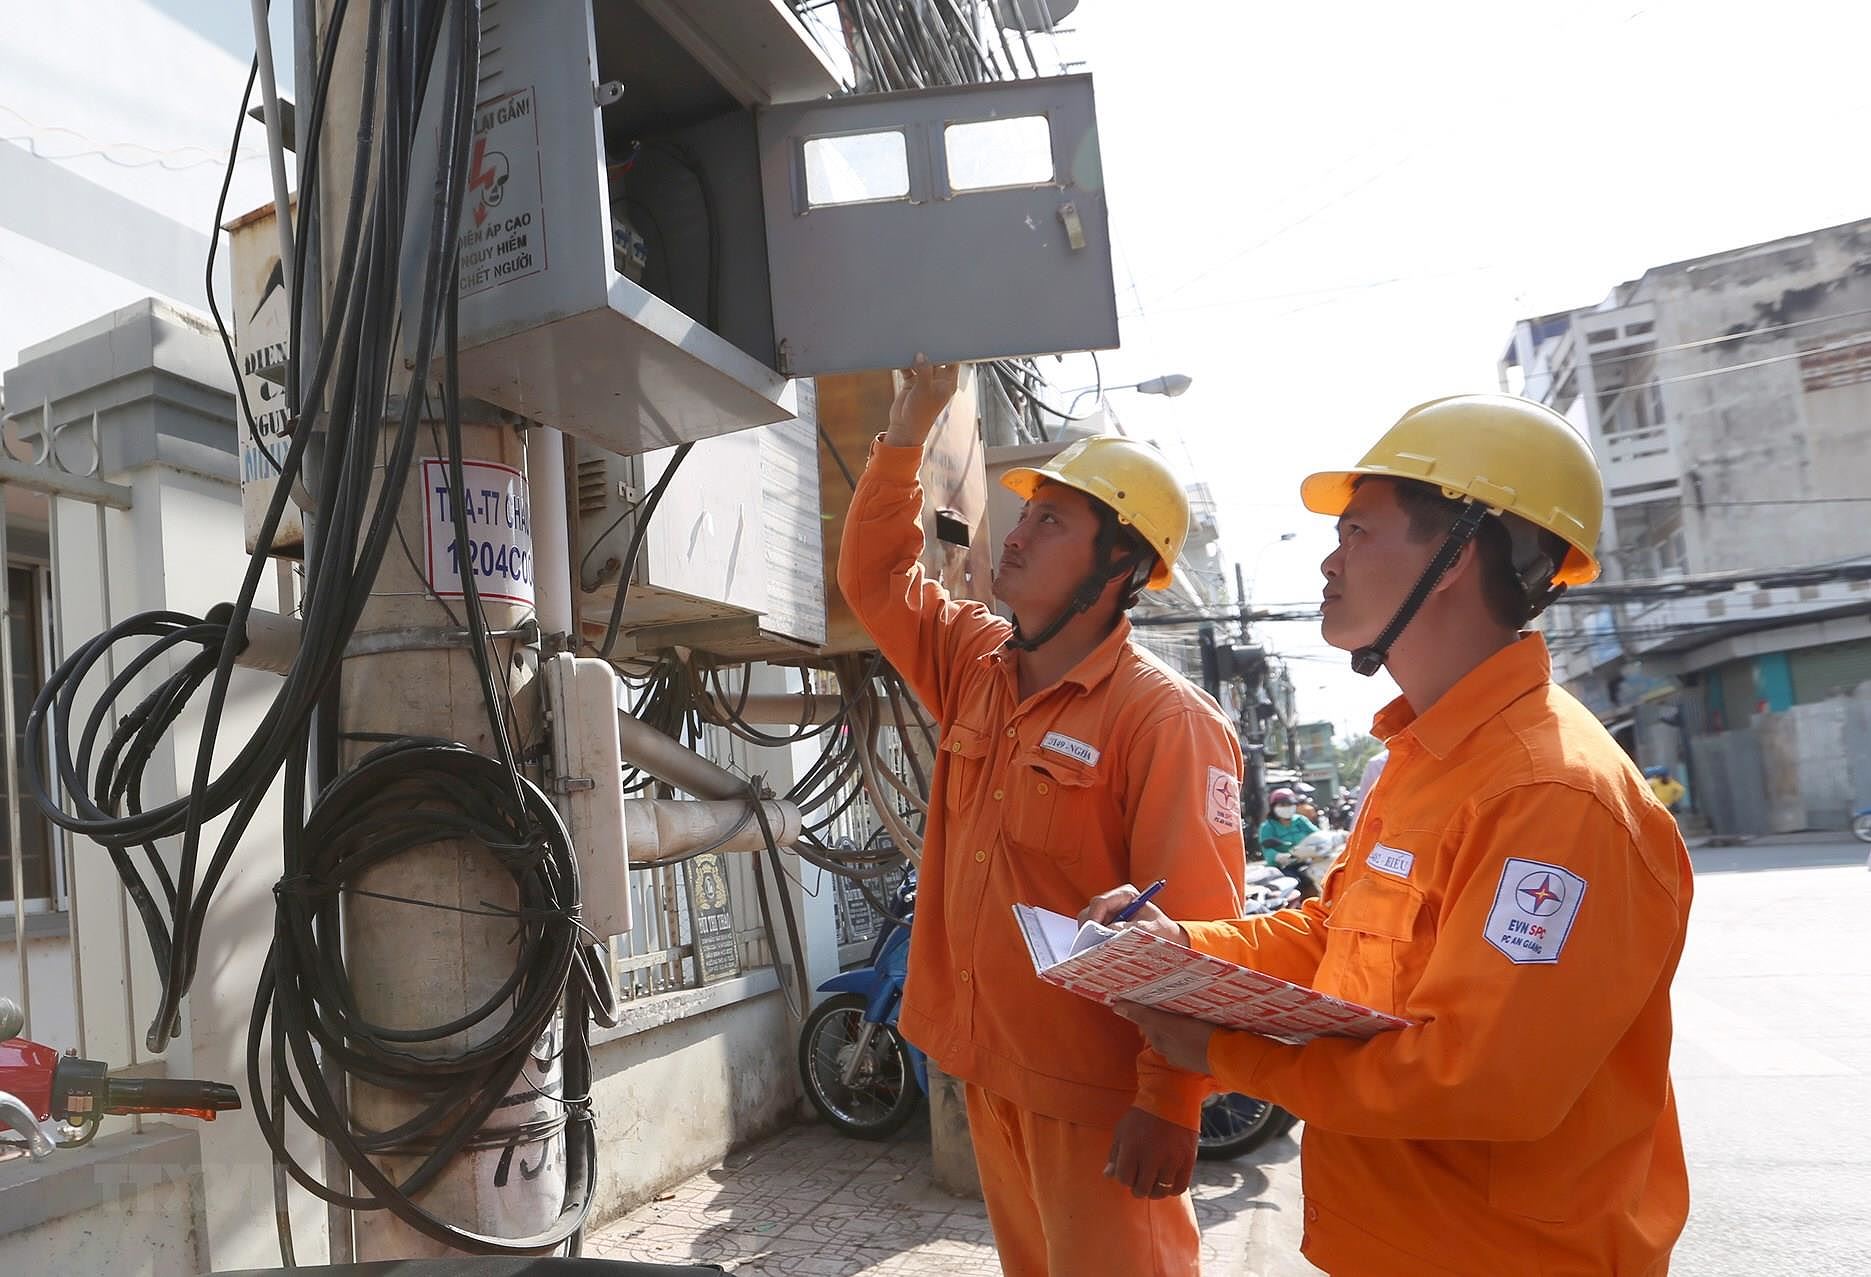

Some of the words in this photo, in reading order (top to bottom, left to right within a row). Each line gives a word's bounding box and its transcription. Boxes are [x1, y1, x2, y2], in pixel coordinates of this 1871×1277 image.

[504, 212, 532, 232] CAO
[460, 246, 493, 268] NGUY
[1508, 918, 1529, 935] EVN
[1528, 924, 1547, 940] SPC
[1500, 934, 1511, 944] PC
[1511, 936, 1523, 947] AN
[1522, 939, 1543, 955] GIANG
